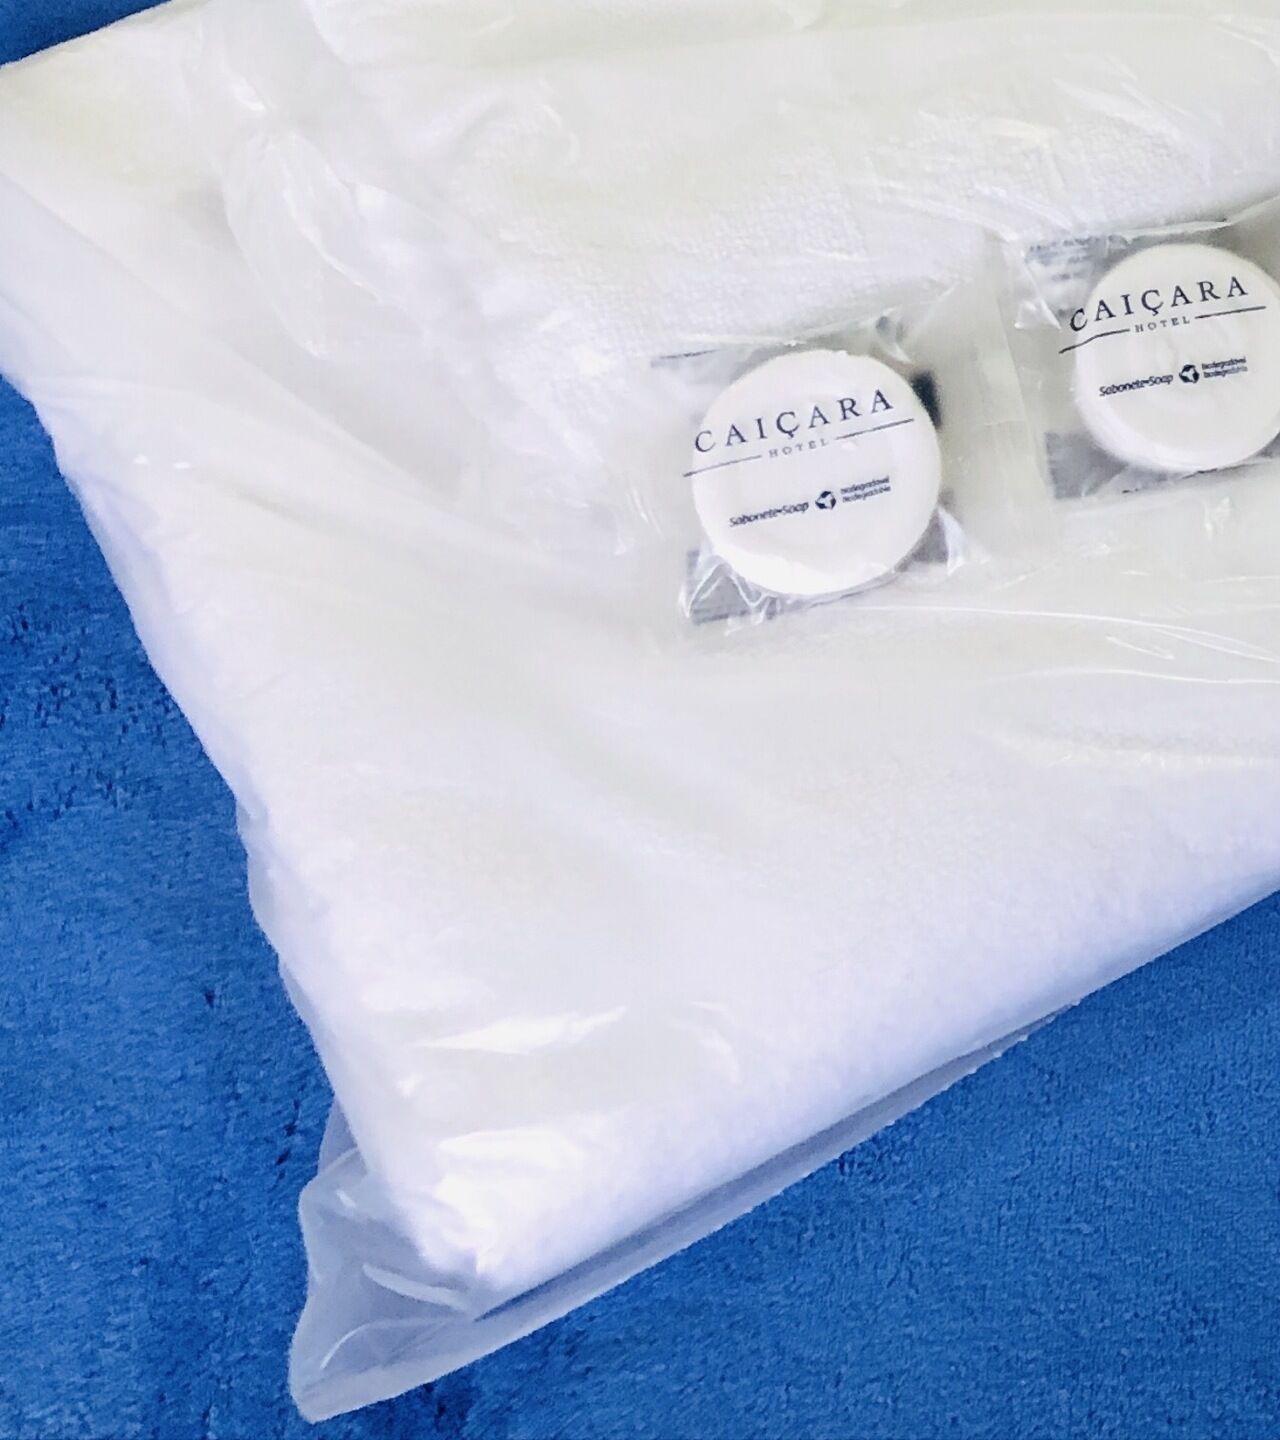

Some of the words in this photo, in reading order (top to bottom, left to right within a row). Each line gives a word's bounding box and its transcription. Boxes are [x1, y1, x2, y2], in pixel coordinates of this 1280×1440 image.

[1069, 276, 1248, 332] CAIÇARA
[1134, 315, 1191, 333] HOTEL
[694, 389, 894, 453] CAIÇARA
[768, 437, 829, 458] HOTEL
